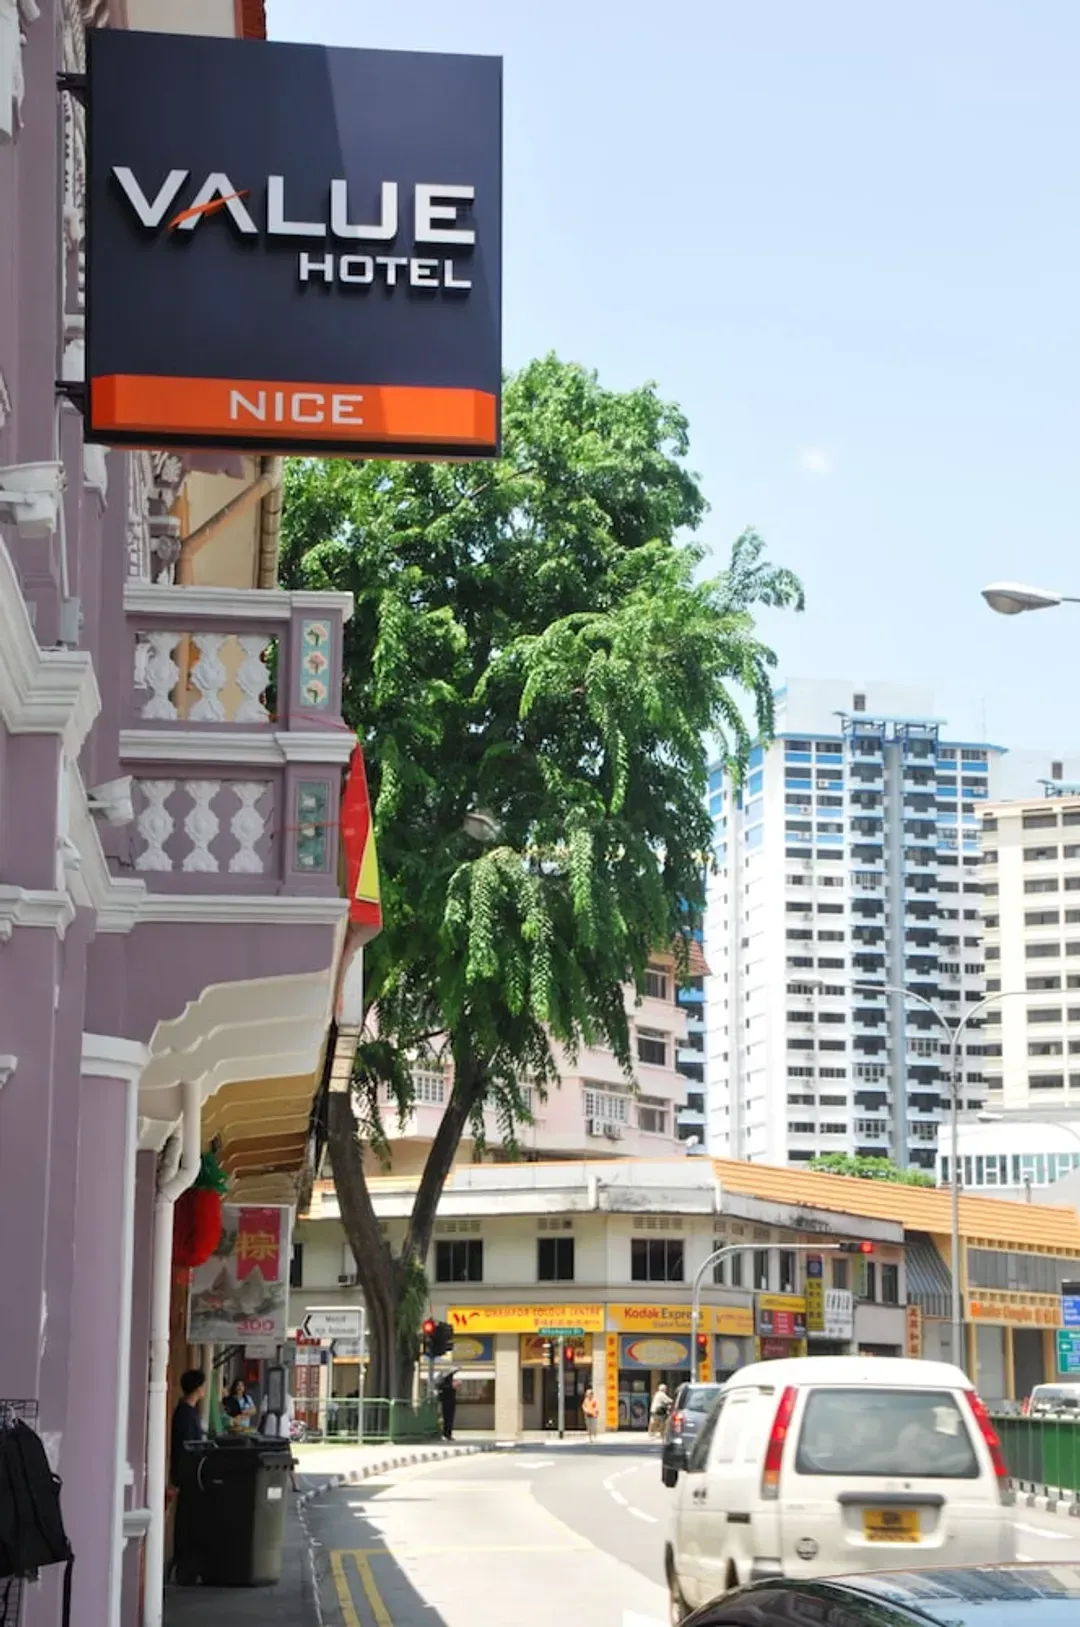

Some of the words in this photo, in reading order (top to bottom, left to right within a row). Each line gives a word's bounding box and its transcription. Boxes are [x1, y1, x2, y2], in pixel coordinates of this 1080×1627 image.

[111, 166, 477, 246] VALUE
[299, 252, 472, 290] HOTEL
[229, 390, 365, 426] NICE
[624, 1307, 659, 1319] Kodak
[661, 1307, 704, 1321] Expres
